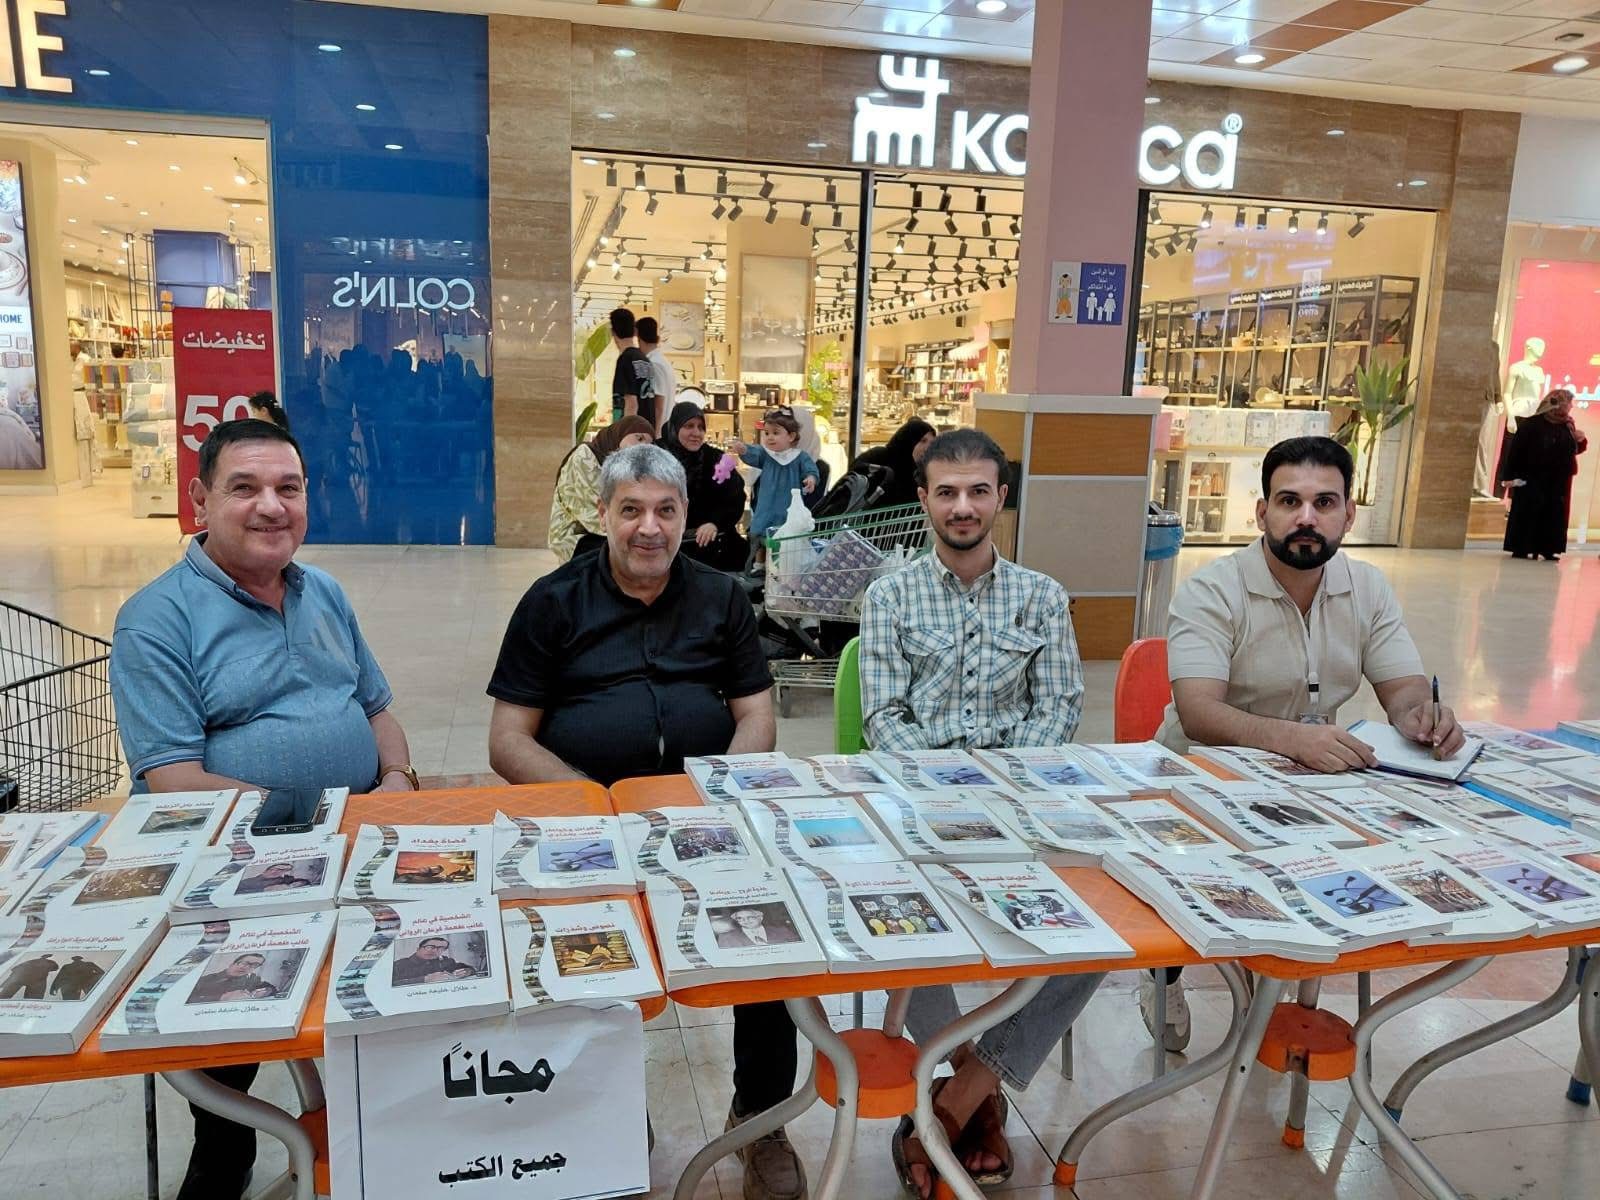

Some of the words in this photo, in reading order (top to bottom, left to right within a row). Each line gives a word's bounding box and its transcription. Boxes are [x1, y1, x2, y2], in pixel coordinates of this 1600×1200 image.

[182, 331, 266, 354] تخفيضات
[442, 1042, 556, 1104] مجاناً
[438, 1154, 504, 1187] الكتب
[511, 1151, 567, 1180] جميع
